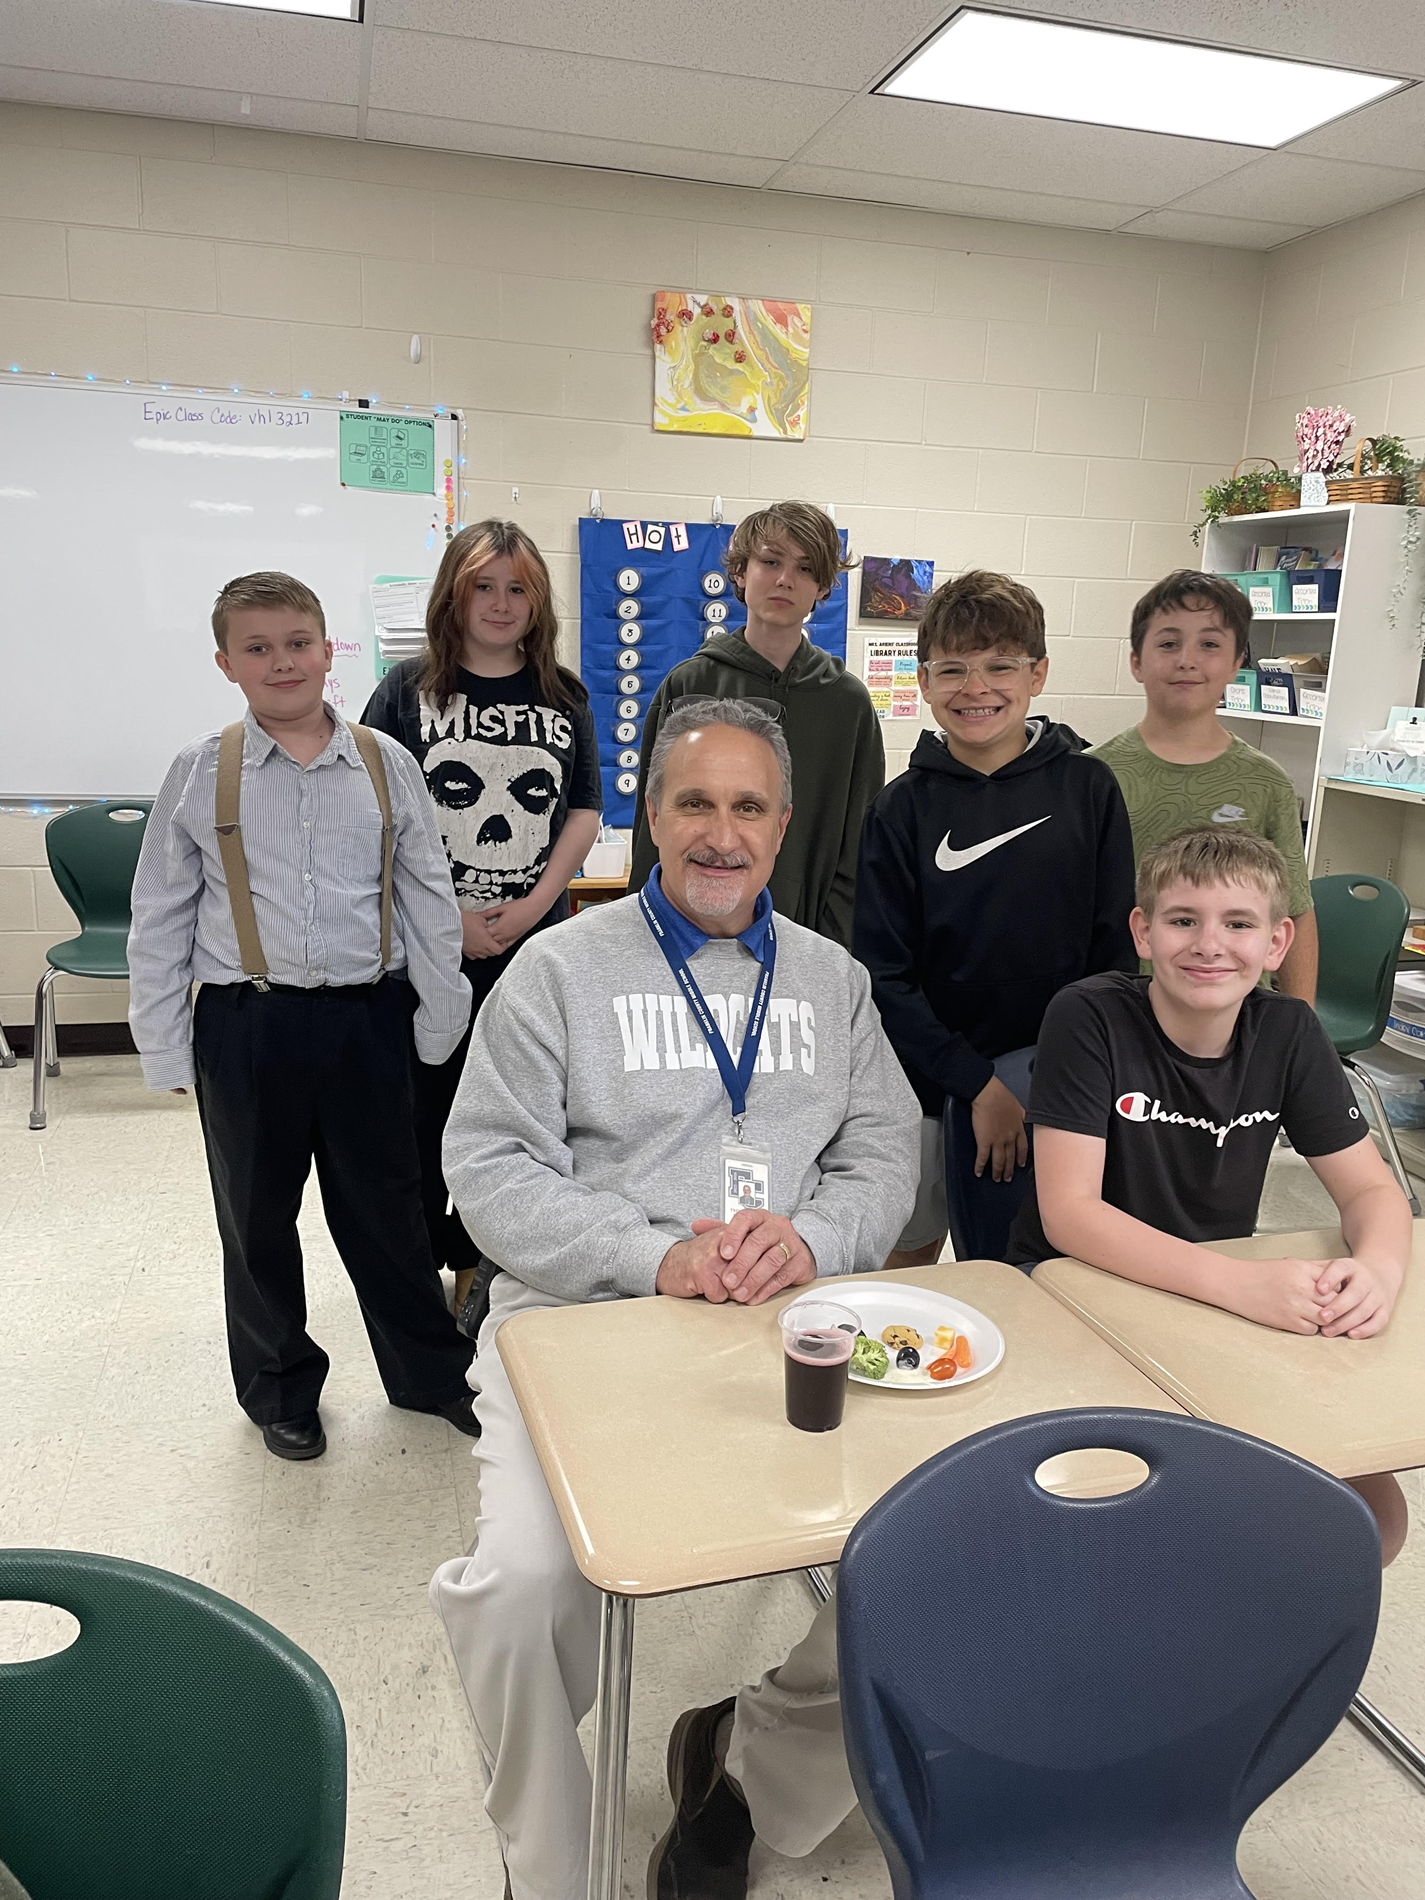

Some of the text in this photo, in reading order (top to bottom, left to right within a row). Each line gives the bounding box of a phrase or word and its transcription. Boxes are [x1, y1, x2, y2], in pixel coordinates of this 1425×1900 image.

[143, 401, 172, 425] Epic
[175, 407, 204, 422] Class
[210, 407, 242, 425] Code:
[345, 413, 372, 421] STUDENT
[625, 575, 632, 586] 1
[707, 579, 720, 589] 10
[624, 605, 632, 614] 2
[711, 608, 723, 618] 11
[626, 628, 634, 637] 3
[870, 649, 918, 657] LIBRARY RULES
[624, 655, 632, 664] 4
[627, 680, 634, 689] 5
[626, 705, 632, 714] 6
[419, 690, 572, 749] MISFITS
[623, 728, 630, 737] 7
[626, 755, 633, 764] 8
[624, 778, 631, 788] 9
